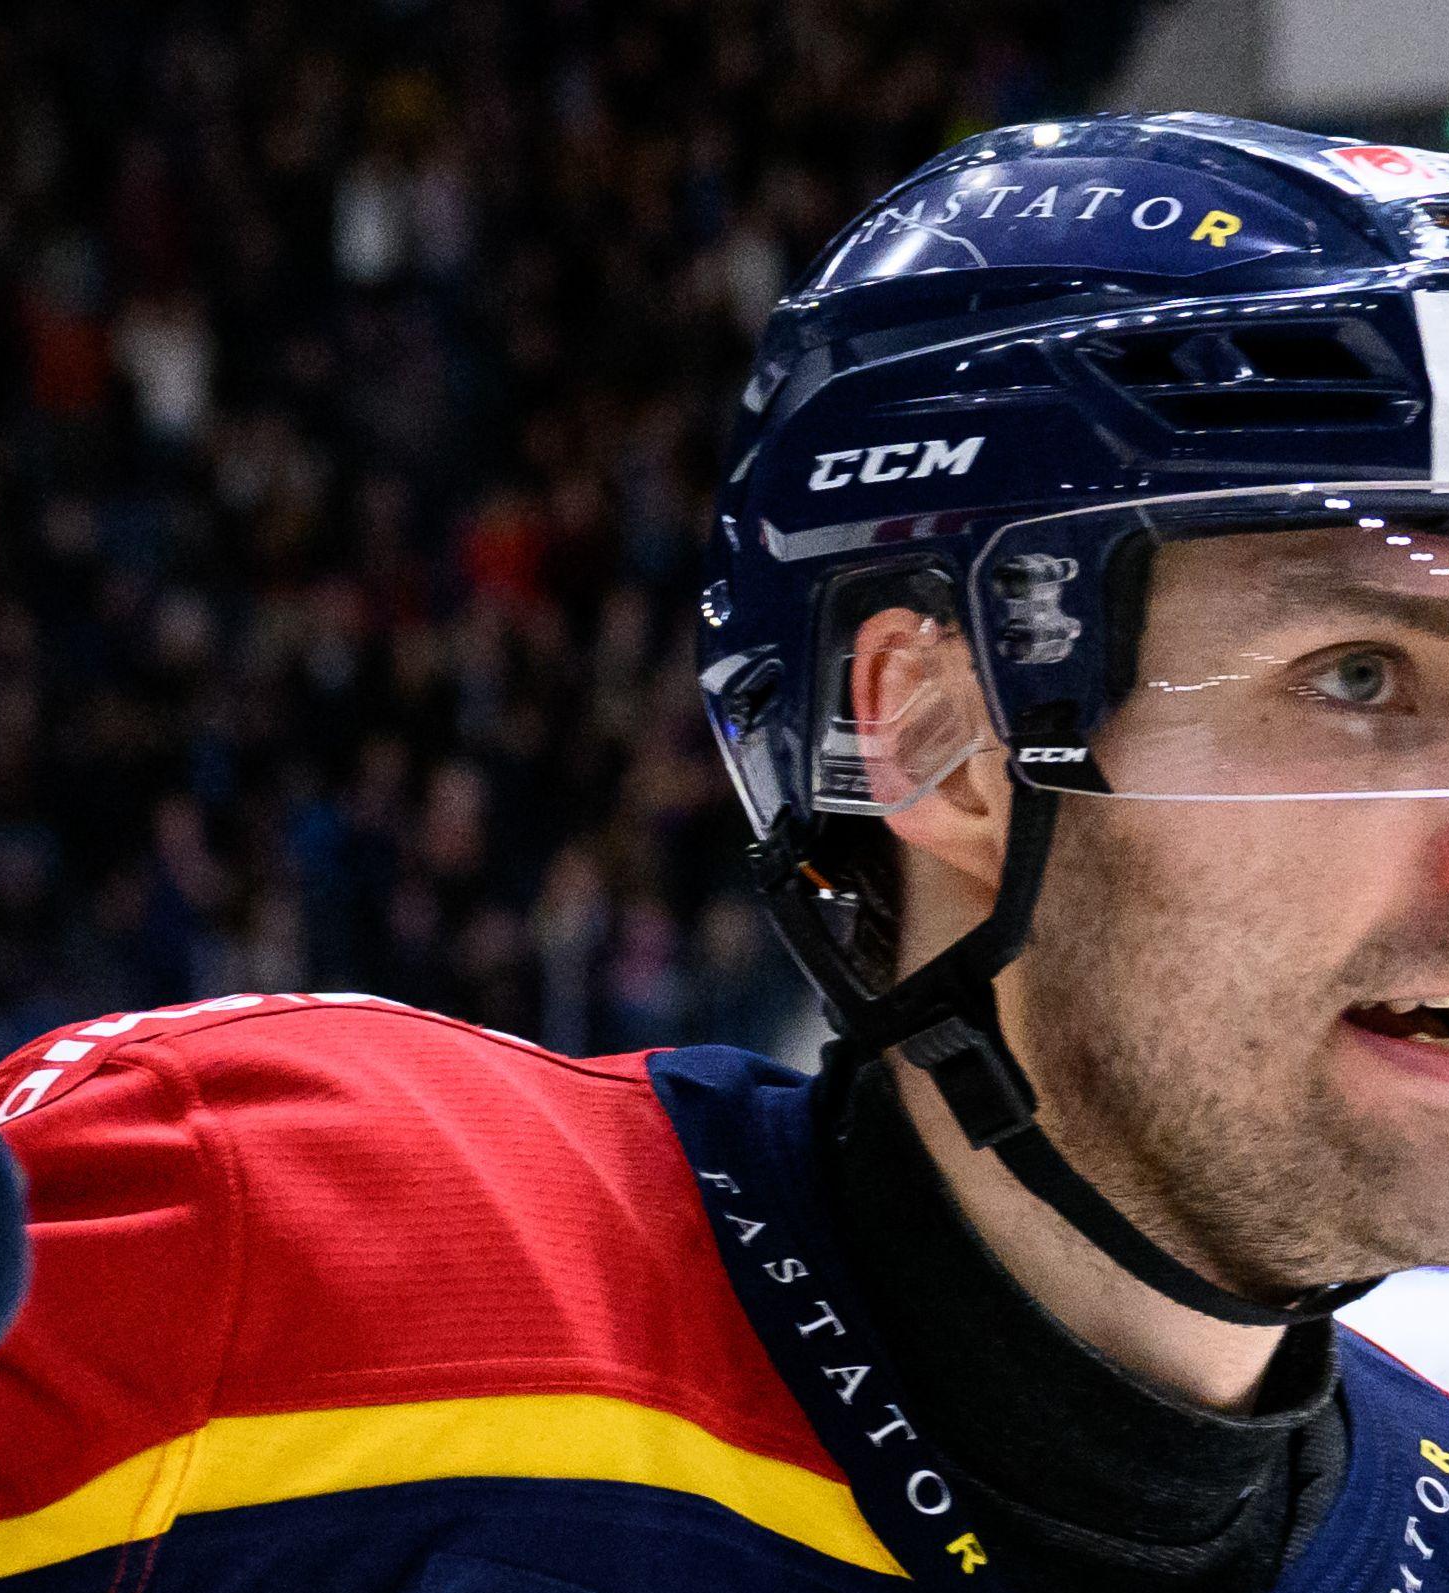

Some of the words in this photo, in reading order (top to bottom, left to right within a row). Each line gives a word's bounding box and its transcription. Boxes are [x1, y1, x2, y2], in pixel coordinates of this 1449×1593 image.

[809, 437, 986, 491] CCM
[1018, 747, 1089, 763] CCM
[700, 1171, 988, 1574] FASTATOR
